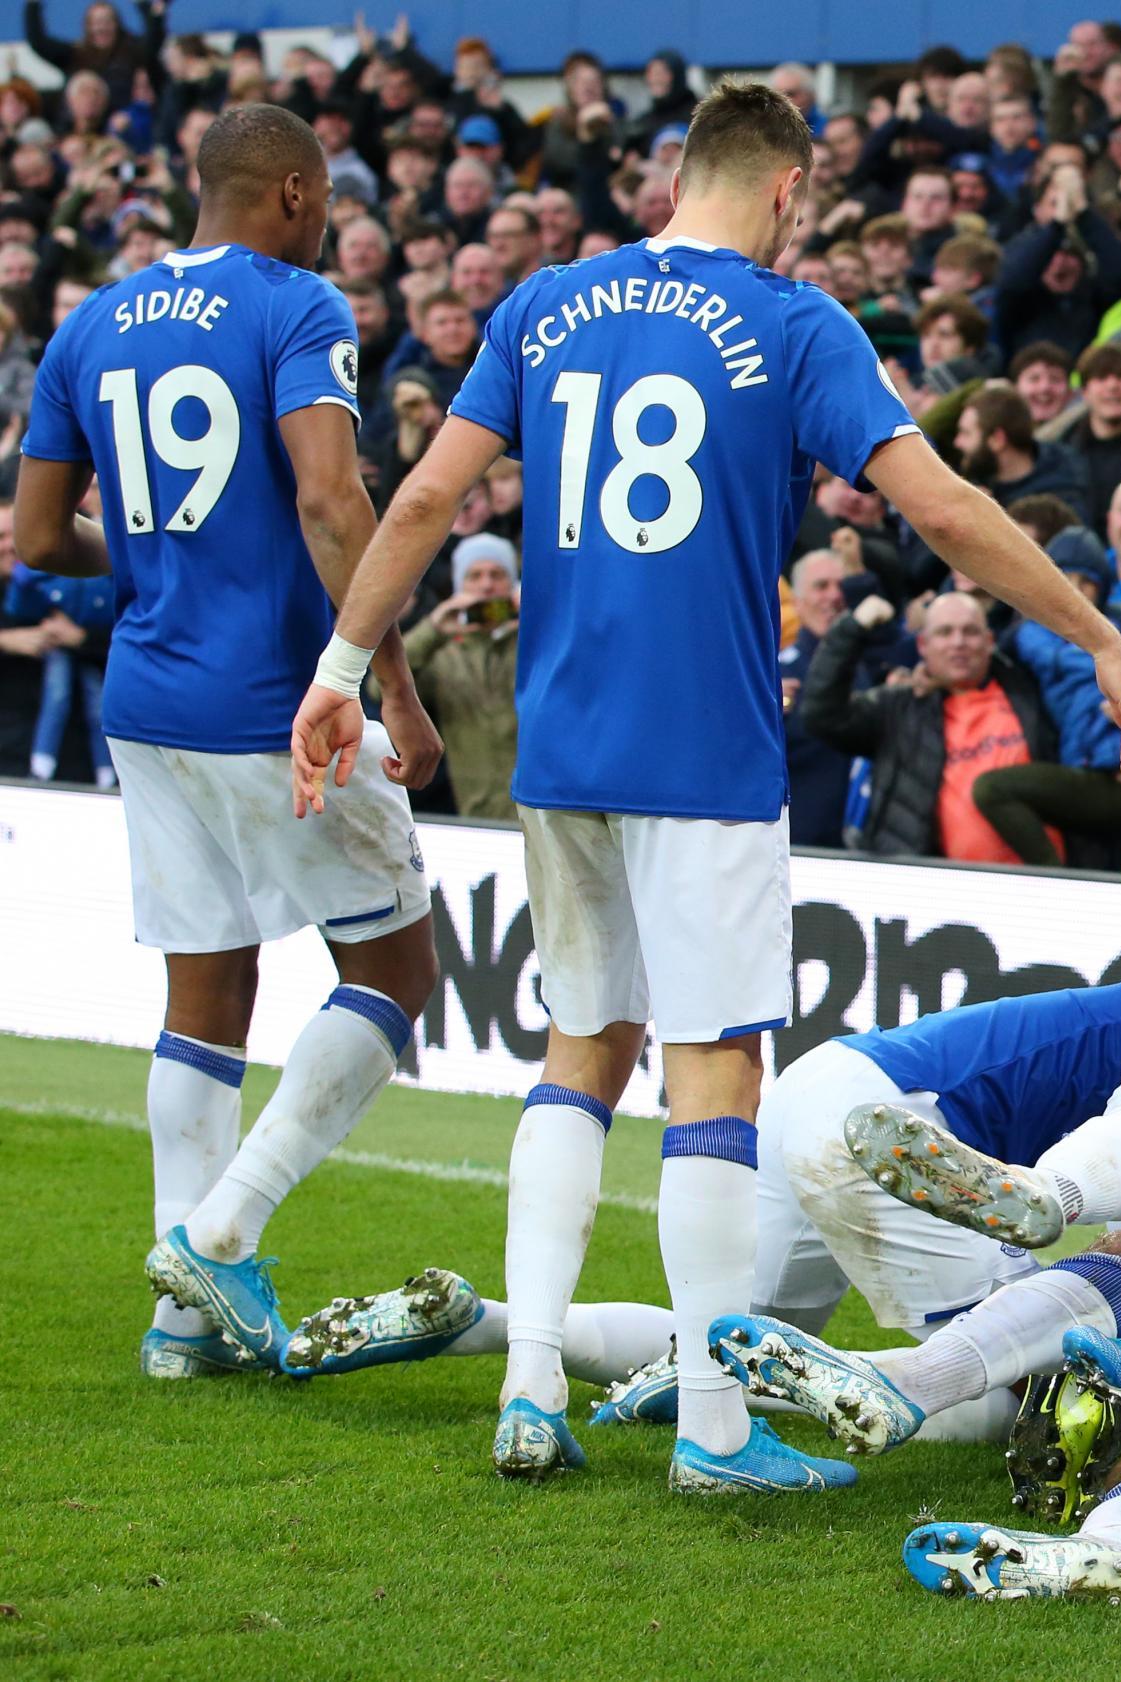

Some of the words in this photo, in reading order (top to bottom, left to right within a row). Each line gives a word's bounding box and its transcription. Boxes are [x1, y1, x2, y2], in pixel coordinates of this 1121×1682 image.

[114, 287, 229, 334] SIDIBE
[521, 278, 769, 390] SCHNEIDERLIN
[99, 364, 241, 535] 19
[551, 371, 707, 554] 18
